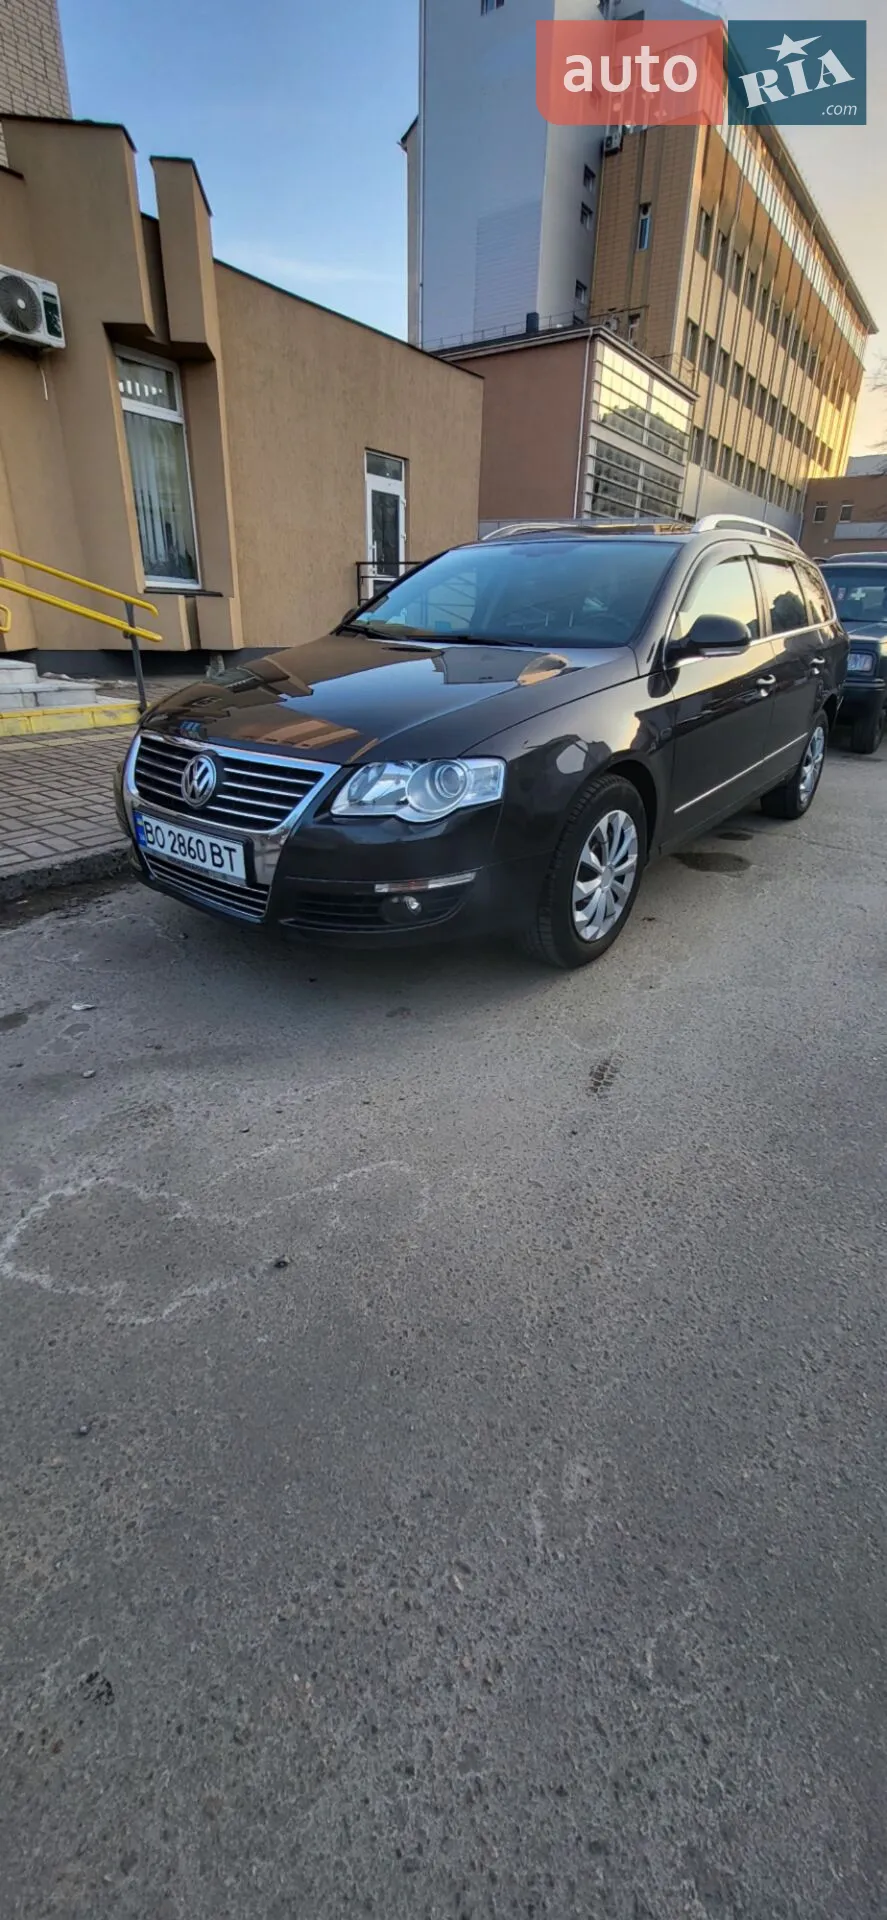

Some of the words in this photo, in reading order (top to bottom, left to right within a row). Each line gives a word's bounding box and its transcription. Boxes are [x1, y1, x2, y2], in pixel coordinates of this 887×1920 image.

[143, 821, 165, 849] BO
[168, 830, 206, 863] 2860
[211, 843, 237, 872] BT
